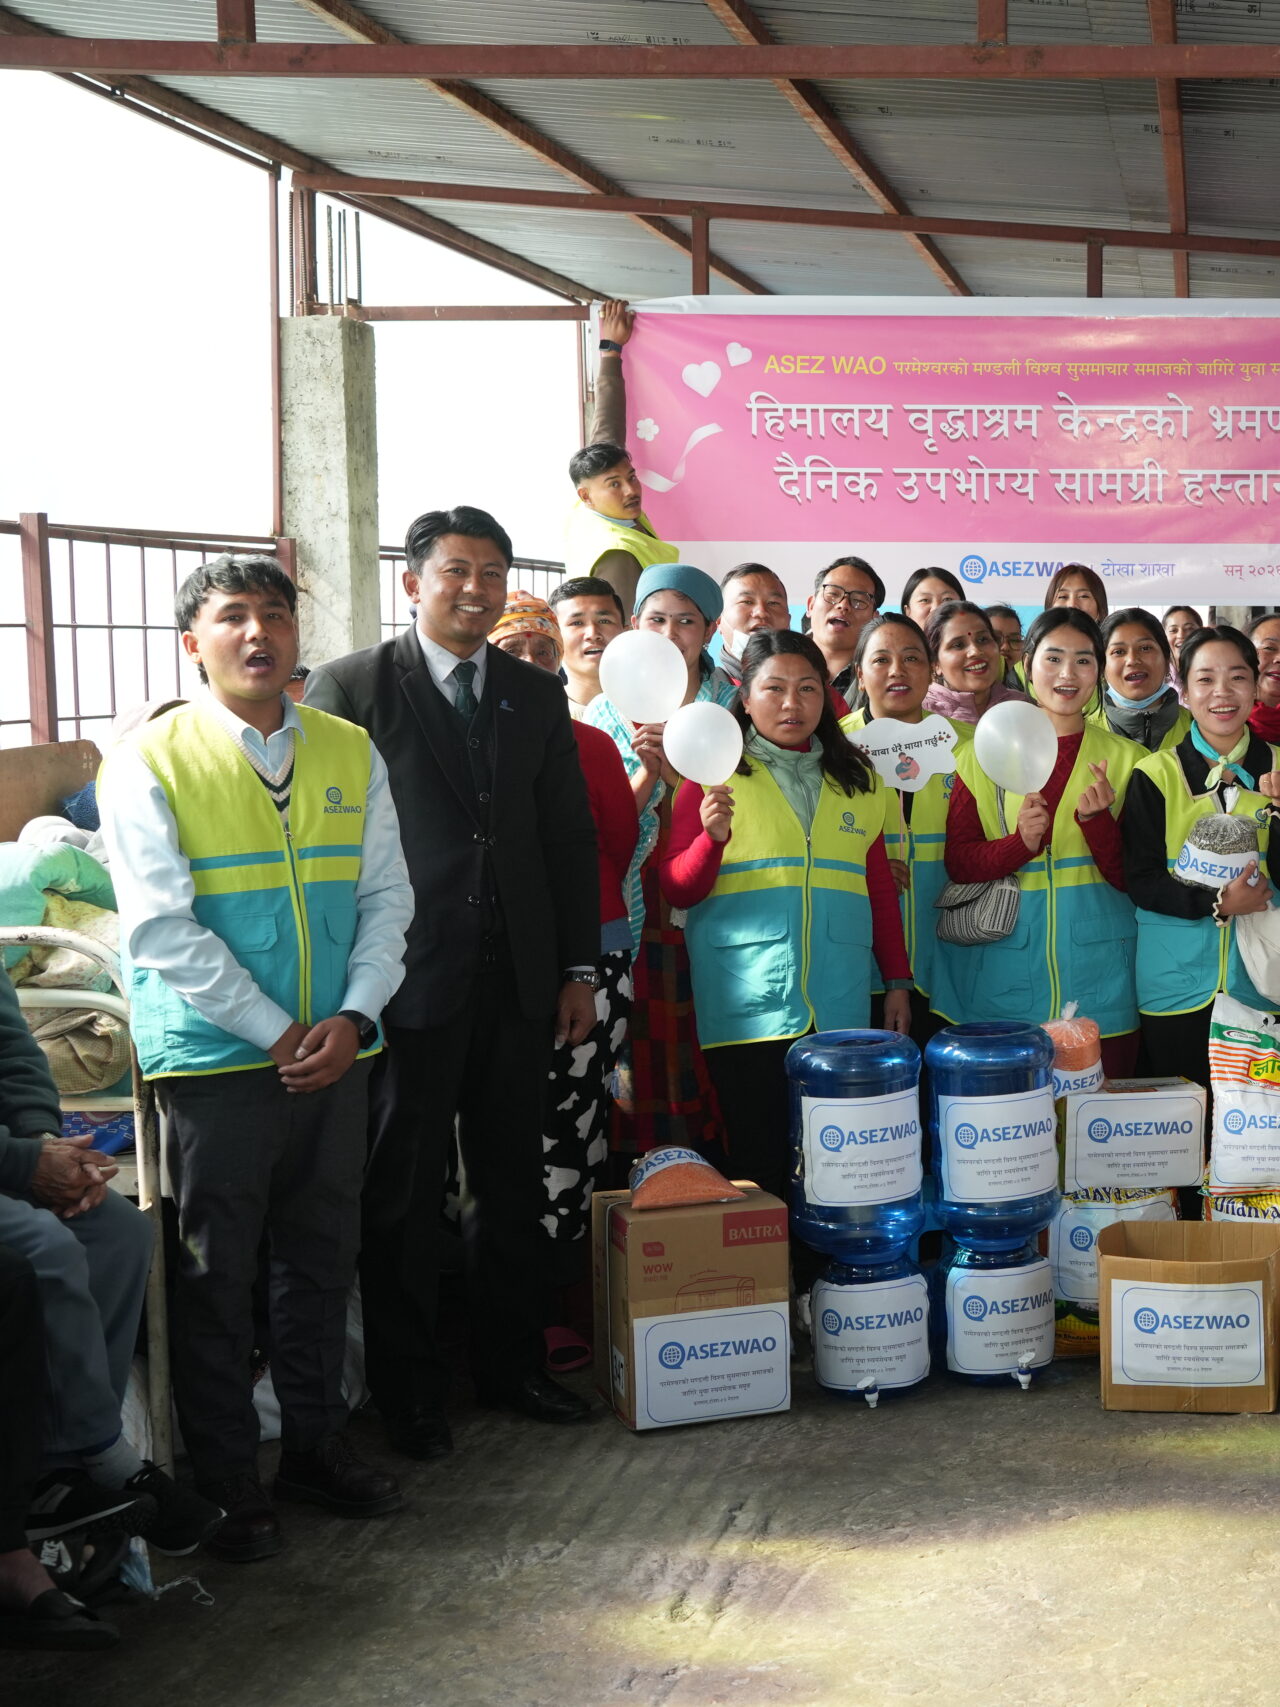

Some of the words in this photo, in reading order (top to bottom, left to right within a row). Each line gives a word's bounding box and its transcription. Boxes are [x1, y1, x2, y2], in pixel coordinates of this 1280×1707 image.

[764, 355, 825, 374] ASEZ
[832, 356, 886, 375] WAO
[893, 358, 969, 376] परमेश्वरको
[972, 359, 1022, 376] मण्डली
[1025, 358, 1062, 376] विश्व
[1067, 362, 1129, 381] सुसमाचार
[1134, 358, 1193, 376] समाजको
[1196, 358, 1236, 376] जागिरे
[1239, 362, 1266, 382] युवा
[745, 391, 894, 441] हिमालय
[902, 404, 1044, 455] वृद्धाश्रम
[1052, 391, 1193, 442] केन्द्रको
[772, 451, 884, 505] दैनिक
[892, 455, 1040, 503] उपभोग्य
[1049, 457, 1168, 503] सामग्री
[988, 561, 1080, 577] ASEZWA
[1101, 559, 1137, 577] टोखा
[1141, 563, 1176, 577] शाखा
[1223, 564, 1247, 581] सन्
[904, 740, 923, 751] माया
[323, 805, 362, 814] ASEZWAO
[1189, 858, 1259, 881] ASEZWO
[845, 1120, 918, 1146] ASEZWAO
[980, 1118, 1053, 1144] ASEZWAO
[1113, 1119, 1193, 1138] ASEZWAO
[729, 1224, 783, 1241] BALTRA
[643, 1262, 674, 1275] WOW
[988, 1288, 1054, 1316] ASEZWAO
[842, 1307, 924, 1331] ASEZWAO
[1160, 1314, 1251, 1331] ASEZWAO
[686, 1336, 777, 1360] ASEZWAO
